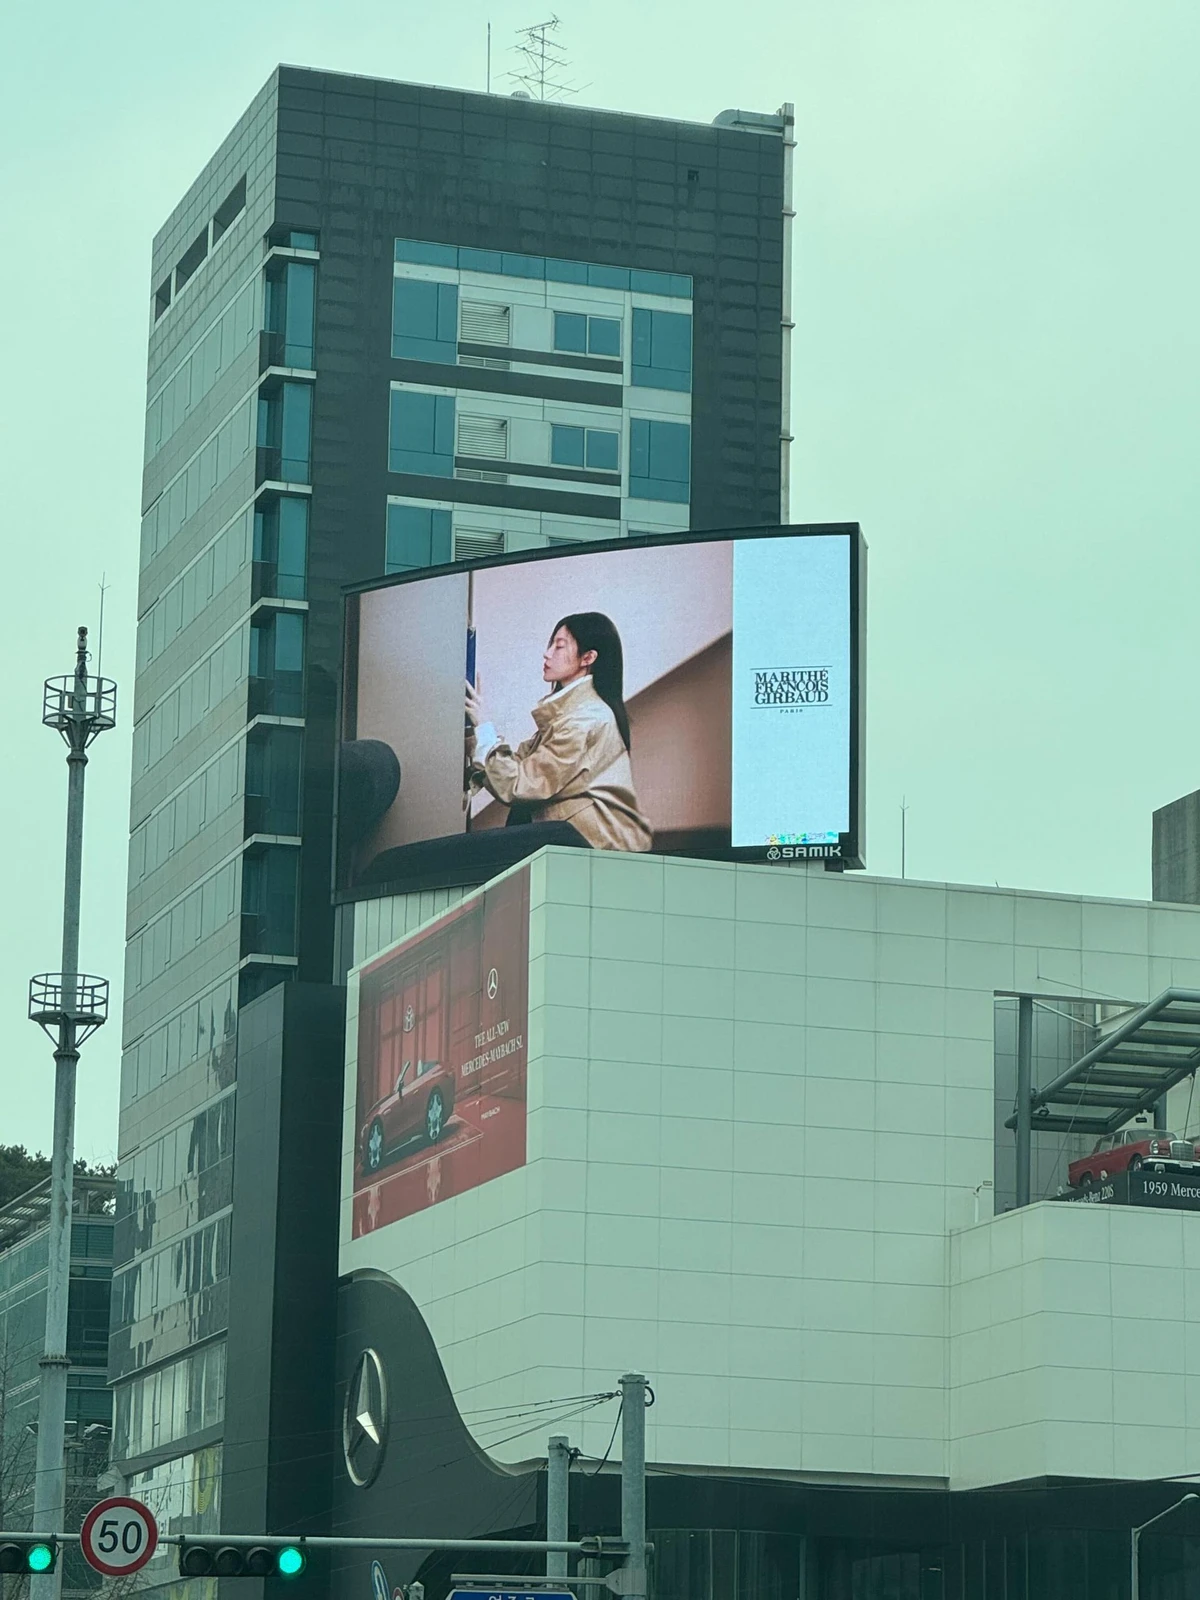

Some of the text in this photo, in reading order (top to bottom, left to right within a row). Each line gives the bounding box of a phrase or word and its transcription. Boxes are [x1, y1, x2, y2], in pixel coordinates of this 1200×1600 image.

[755, 668, 829, 683] MARITHÉ
[755, 691, 829, 705] GIRBAUD
[782, 846, 842, 858] SAMIK
[1143, 1181, 1168, 1196] 1959
[98, 1520, 142, 1554] 50
